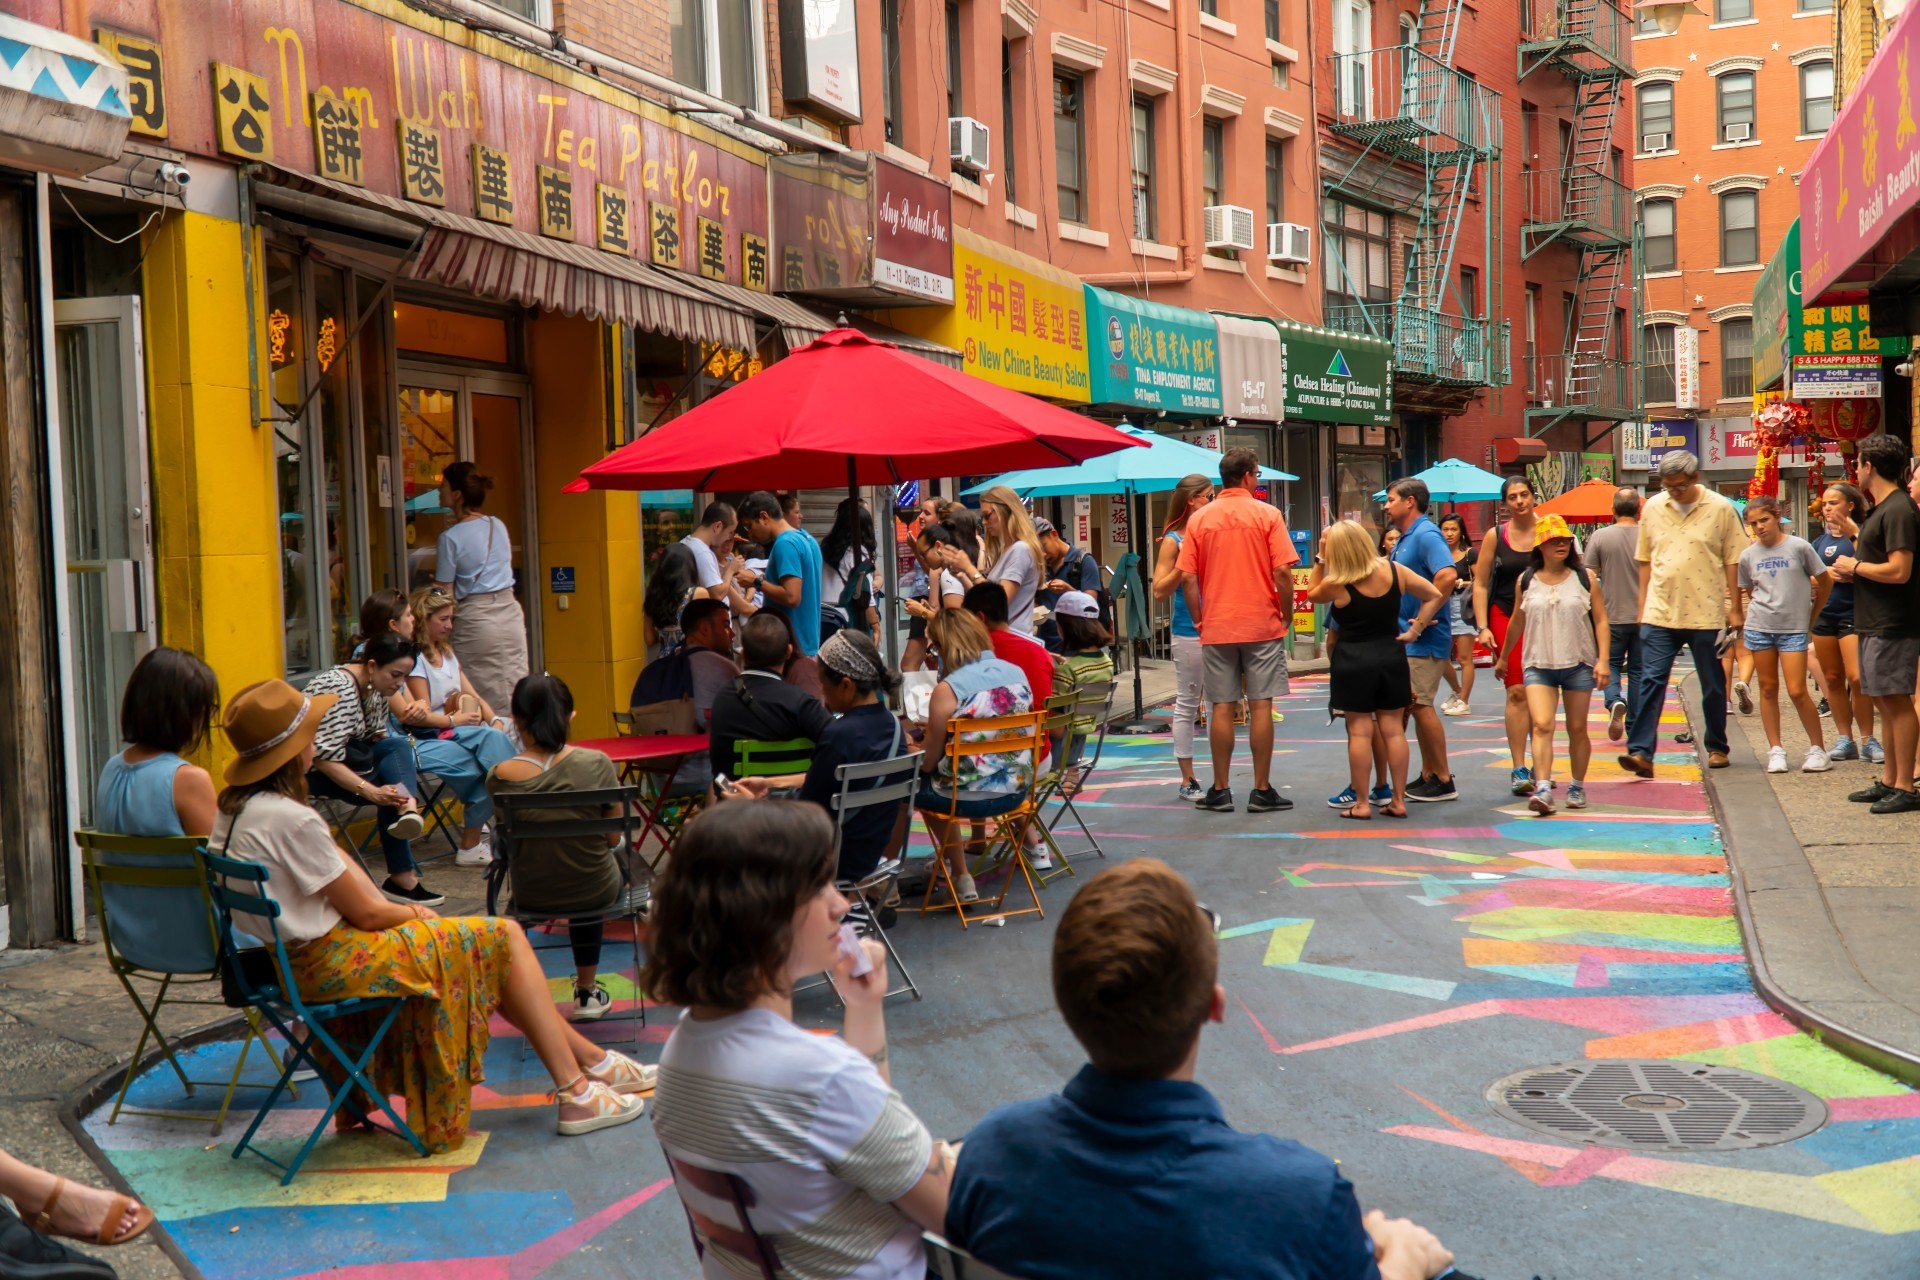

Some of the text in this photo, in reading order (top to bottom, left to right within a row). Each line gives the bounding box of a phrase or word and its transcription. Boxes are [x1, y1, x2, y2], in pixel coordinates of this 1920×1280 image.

[391, 36, 483, 129] Wah
[537, 94, 597, 171] Tea
[618, 123, 731, 217] Parlor
[879, 192, 948, 243] Any Product Inc.
[1858, 183, 1884, 238] Baishi
[886, 265, 902, 284] 11-13
[904, 275, 921, 290] Doyers
[978, 340, 1001, 371] New
[1003, 347, 1031, 377] China
[1033, 355, 1063, 389] Beauty
[1065, 361, 1088, 388] Salon
[1820, 356, 1845, 364] HAPPY
[1135, 366, 1151, 384] TINA
[1152, 369, 1191, 390] EMPLOYMENT
[1193, 375, 1215, 393] AGENCY
[1241, 380, 1266, 400] 15-17
[1293, 373, 1381, 400] Chelsea Healing (Chinatown)
[1240, 402, 1269, 416] Doyers St.
[1297, 393, 1326, 406] ACUPUNCTURE
[1708, 423, 1721, 464] 美容
[1756, 560, 1789, 571] PENN
